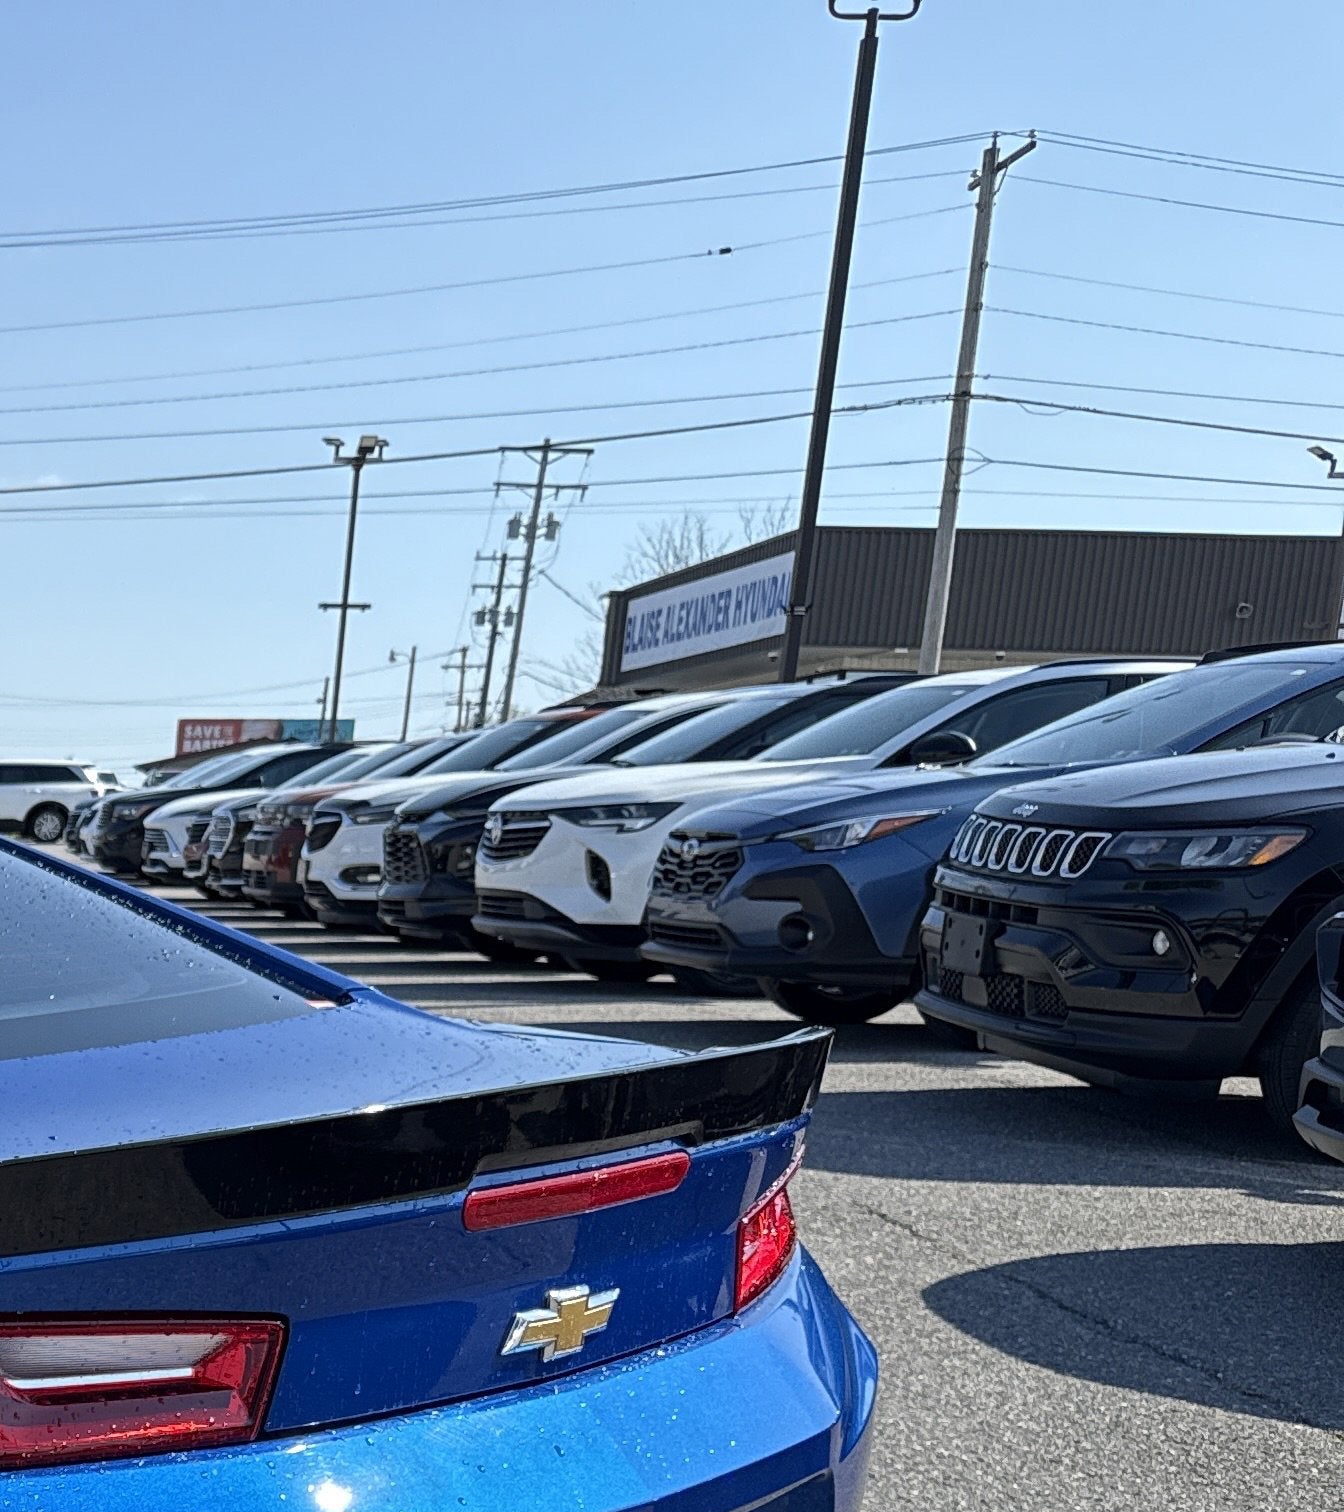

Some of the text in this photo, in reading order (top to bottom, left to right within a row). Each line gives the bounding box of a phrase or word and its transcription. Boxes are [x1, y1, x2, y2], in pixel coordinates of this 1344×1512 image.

[624, 571, 791, 655] BLAISE ALEXANDER HYUNDAI
[184, 724, 221, 738] SAVE
